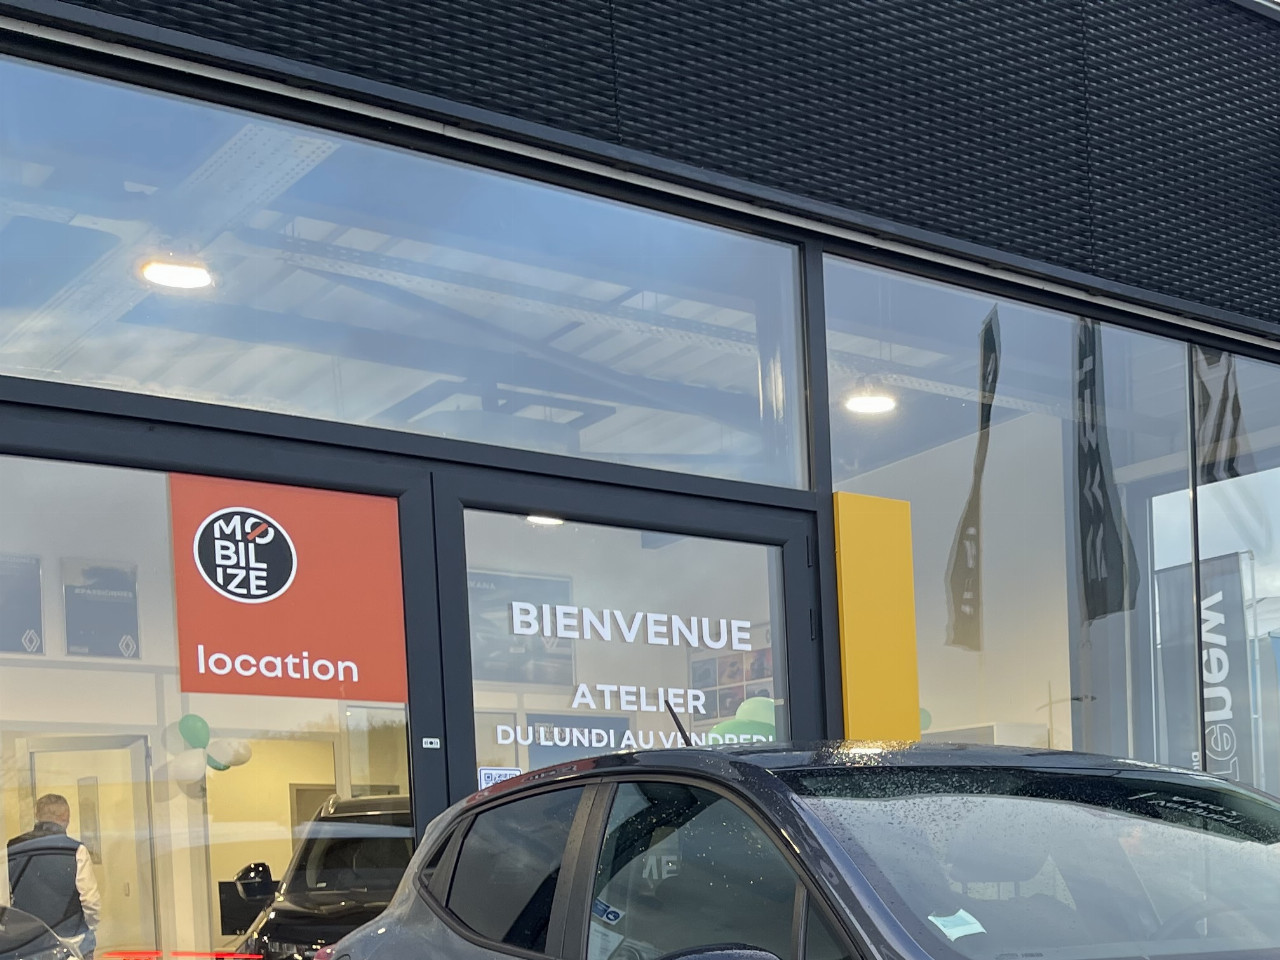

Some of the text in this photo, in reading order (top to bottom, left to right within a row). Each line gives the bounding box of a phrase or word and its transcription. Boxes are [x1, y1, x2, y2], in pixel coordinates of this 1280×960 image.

[511, 601, 752, 651] BIENVENUE
[197, 644, 359, 682] location
[571, 683, 706, 715] ATELIER
[496, 724, 534, 747] DU
[539, 726, 615, 748] LUNDI
[620, 730, 654, 749] AU
